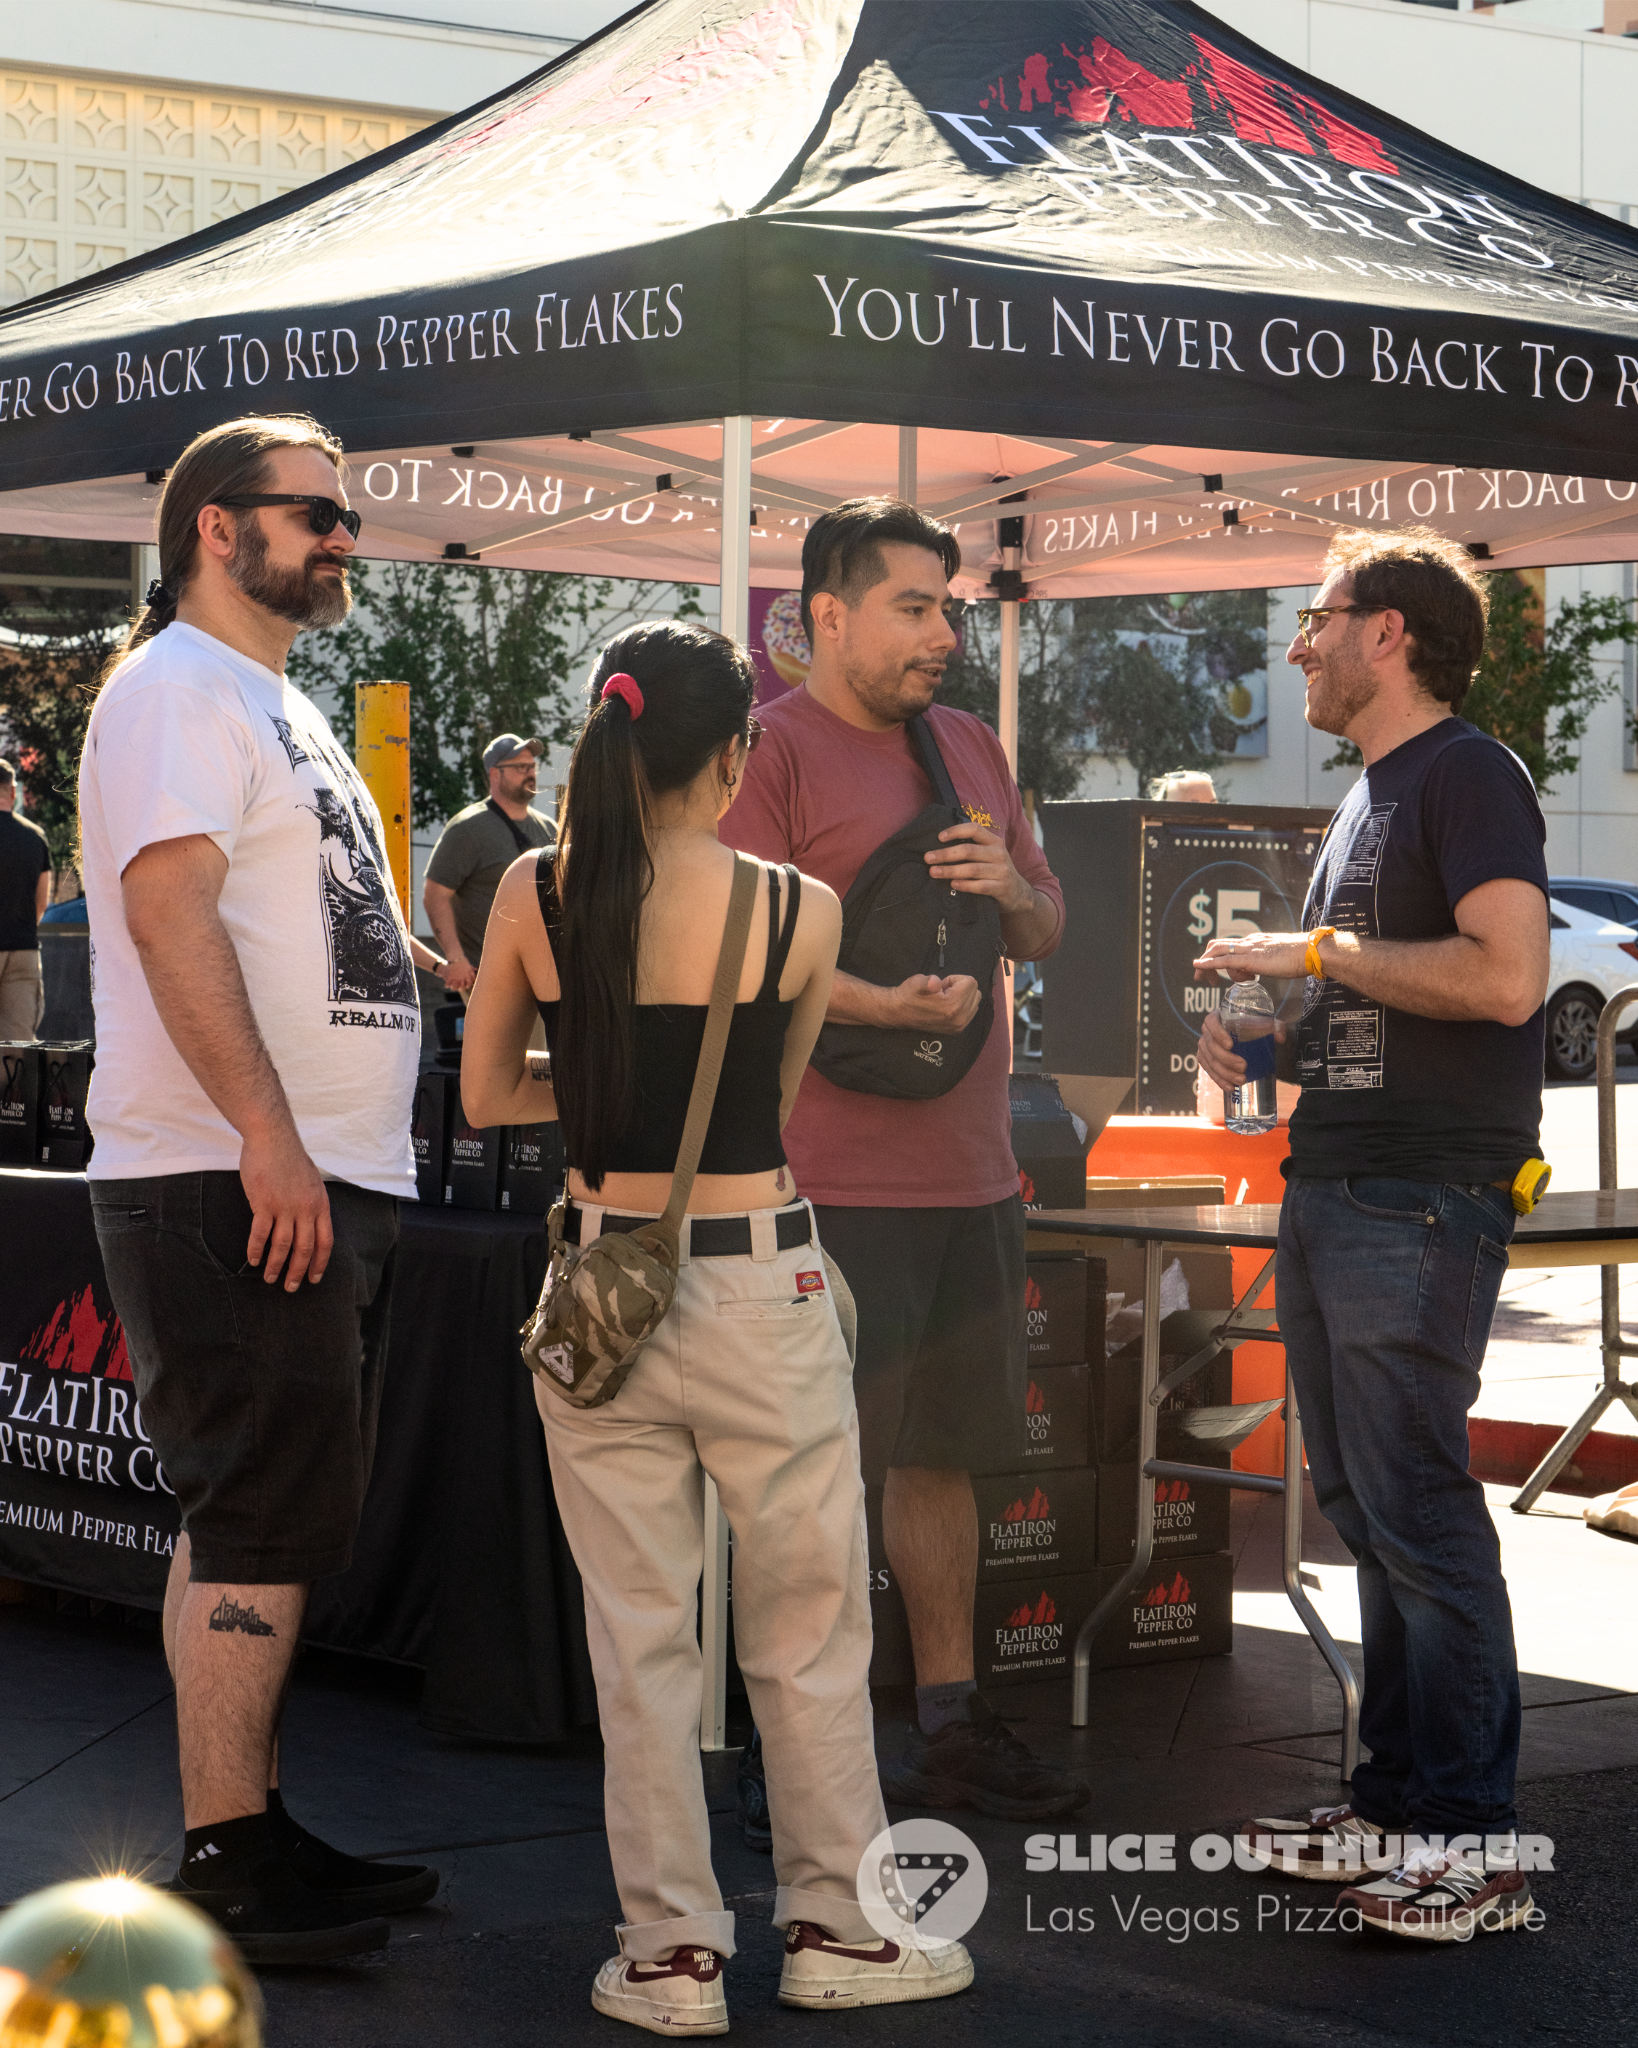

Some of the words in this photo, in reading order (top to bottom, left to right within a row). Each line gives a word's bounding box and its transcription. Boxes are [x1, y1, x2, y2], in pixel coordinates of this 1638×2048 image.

[926, 110, 1534, 235] FLATIRON
[1038, 171, 1417, 247] PEPPER
[1408, 216, 1555, 270] CO
[813, 274, 1027, 354] YOU'LL
[1050, 297, 1245, 374] NEVER
[1260, 318, 1347, 379] GO
[1369, 326, 1508, 394] BACK
[1520, 341, 1594, 402] TO
[44, 362, 98, 414] GO
[115, 345, 207, 404] BACK
[218, 333, 270, 388] TO
[285, 326, 359, 382] RED
[376, 307, 521, 372] PEPPER
[535, 283, 684, 353] FLAKES
[328, 1009, 403, 1031] REALM
[405, 1015, 416, 1033] OF
[453, 1138, 484, 1150] FLATIRON
[454, 1147, 471, 1157] PEPPER
[1031, 1428, 1047, 1440] CO
[0, 1421, 120, 1487] PEPPER
[71, 1510, 138, 1549] PEPPER
[990, 1519, 1056, 1539] FLATIRON
[1176, 1515, 1192, 1527] CO
[994, 1536, 1033, 1550] PEPPER
[1035, 1534, 1052, 1546] CO
[1179, 1533, 1197, 1541] FLAKES
[985, 1558, 1014, 1566] PREMIUM
[1016, 1555, 1037, 1563] PEPPER
[1038, 1552, 1059, 1561] FLAKES
[1133, 1603, 1197, 1622] FLATIRON
[995, 1623, 1063, 1644] FLATIRON
[1137, 1620, 1173, 1634] PEPPER
[1176, 1617, 1193, 1629] CO
[1000, 1642, 1039, 1656] PEPPER
[1042, 1638, 1059, 1650] CO
[1129, 1641, 1156, 1649] PREMIUM
[1158, 1638, 1178, 1646] PEPPER
[1179, 1635, 1199, 1644] FLAKES
[992, 1663, 1020, 1673] PREMIUM
[1022, 1660, 1044, 1668] PEPPER
[1045, 1656, 1066, 1665] FLAKES
[693, 1951, 715, 1963] NIKE
[699, 1961, 714, 1972] AIR
[822, 1990, 837, 2000] AIR
[661, 2015, 672, 2025] AIR
